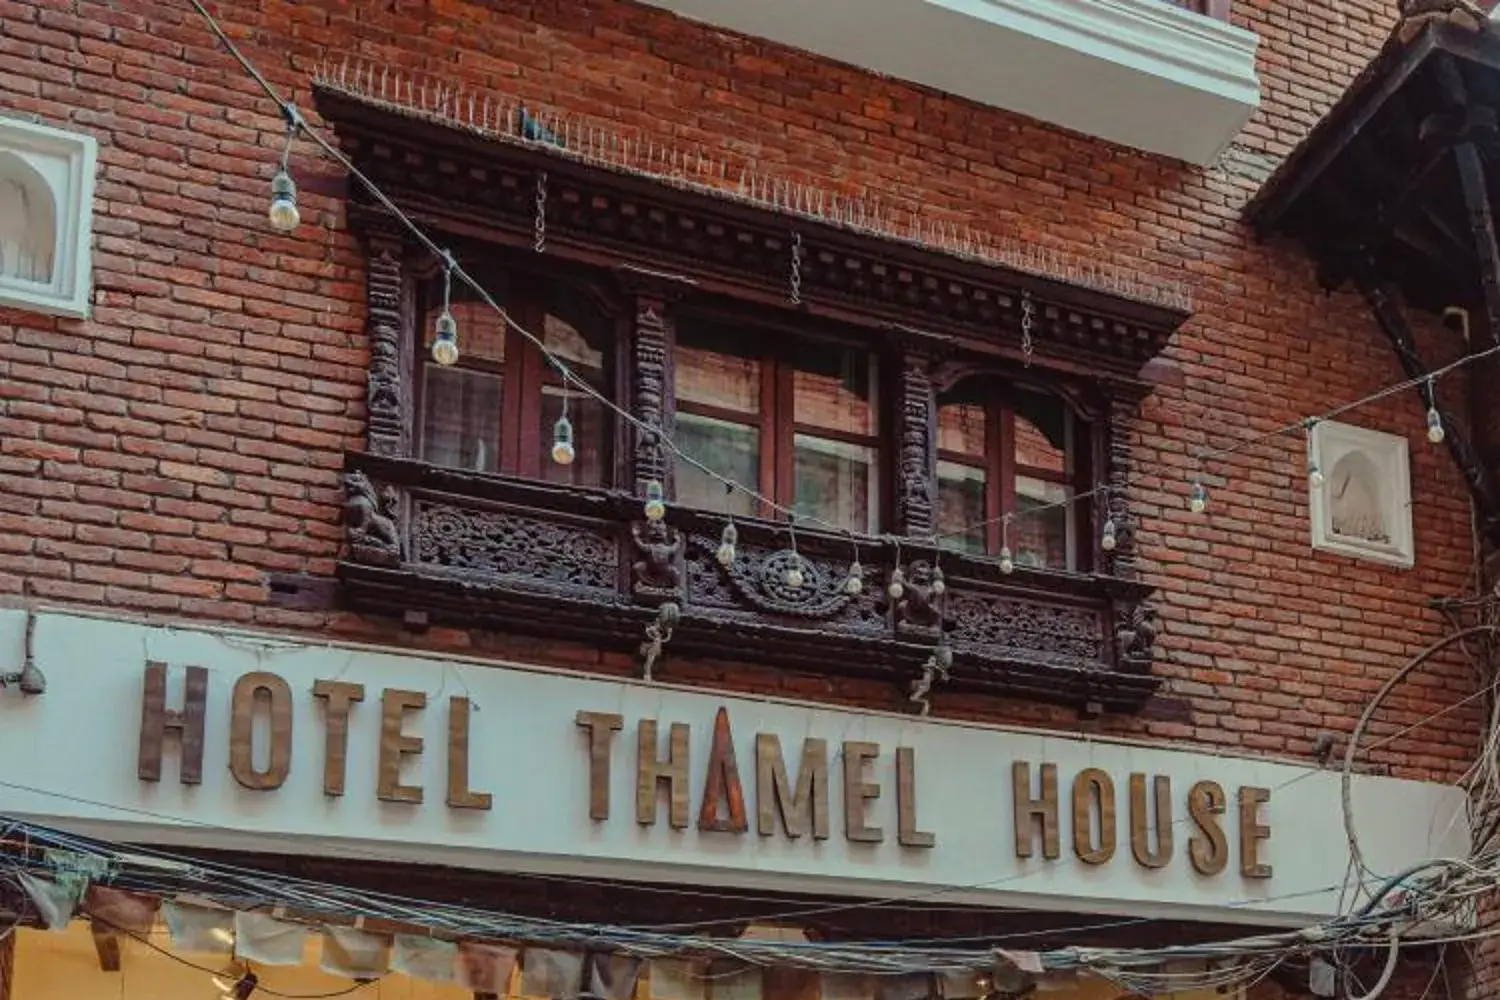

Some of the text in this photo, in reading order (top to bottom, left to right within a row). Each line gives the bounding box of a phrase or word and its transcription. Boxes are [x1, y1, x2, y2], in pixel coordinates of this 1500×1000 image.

[137, 660, 1273, 879] HOTEL THAMEL HOUSE
